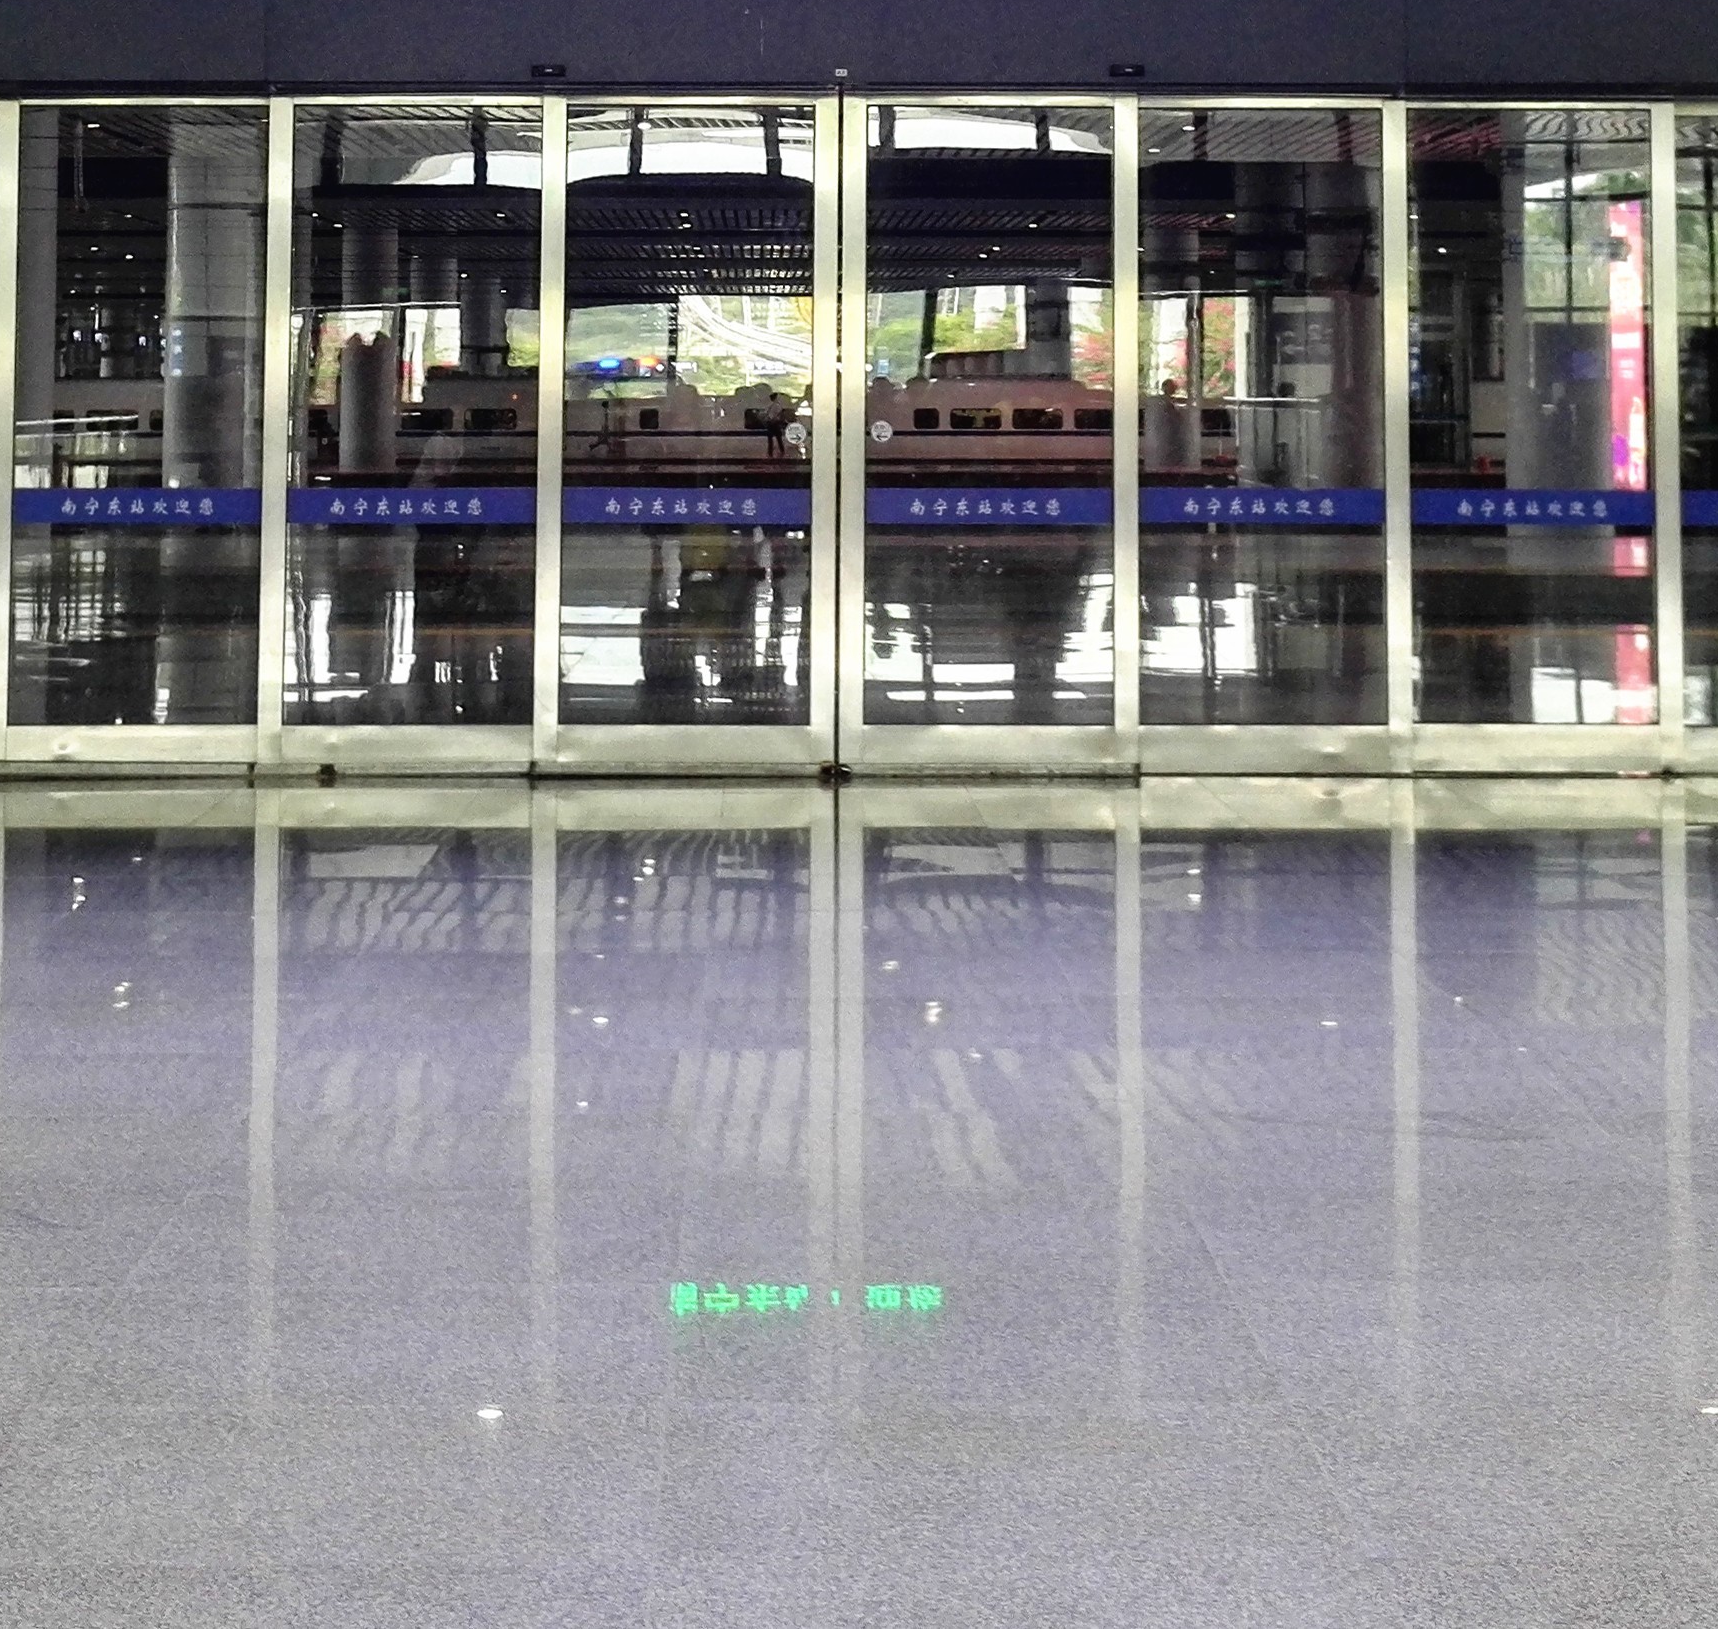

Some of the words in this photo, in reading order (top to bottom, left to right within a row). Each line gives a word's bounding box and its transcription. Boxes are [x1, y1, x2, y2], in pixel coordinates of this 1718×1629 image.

[60, 496, 214, 517] 南宁东站欢迎您
[329, 496, 483, 517] 南宁东站欢迎您
[604, 496, 757, 517] 南宁东站欢迎您
[910, 497, 1061, 517] 南宁东站欢迎您
[1183, 497, 1335, 517] 南宁东站欢迎您
[1457, 497, 1609, 518] 南宁东站欢迎您
